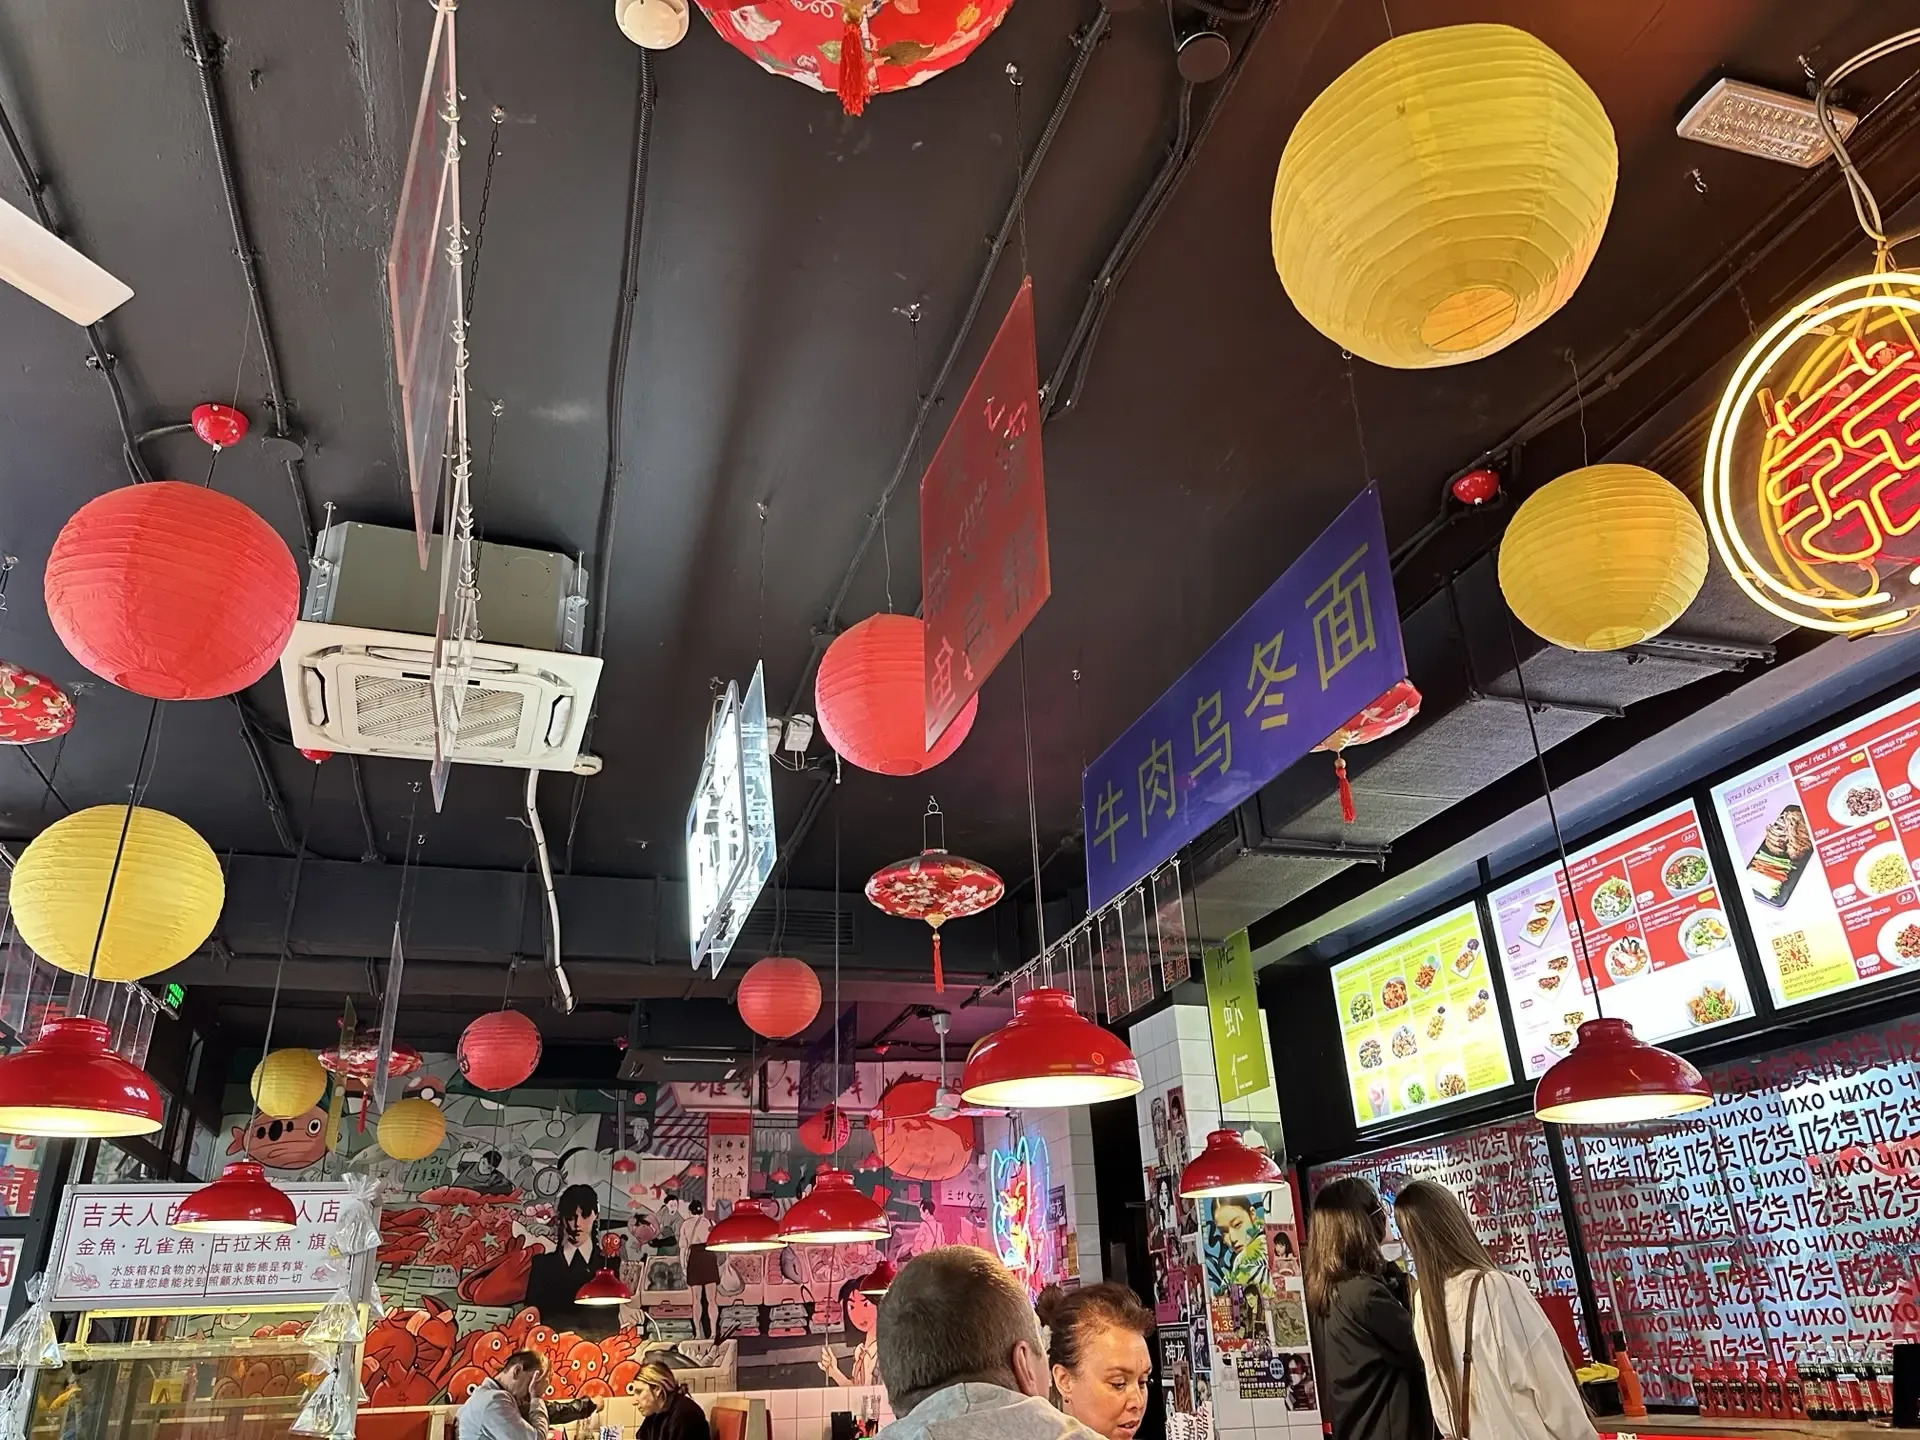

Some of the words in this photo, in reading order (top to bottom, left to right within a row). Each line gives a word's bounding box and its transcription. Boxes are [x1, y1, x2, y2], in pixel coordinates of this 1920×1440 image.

[1093, 542, 1376, 863] 牛肉乌冬面
[1793, 759, 1809, 773] рис
[1811, 750, 1827, 763] rice
[1727, 792, 1743, 804] утка
[1746, 781, 1762, 794] duck
[1815, 1031, 1889, 1083] 吃货
[1710, 1105, 1763, 1130] ЧИХО
[1767, 1092, 1826, 1118] ЧИХО
[1829, 1077, 1894, 1104] ЧИХО
[1897, 1071, 1920, 1092] Ч
[1469, 1127, 1508, 1162] 吃货
[1587, 1153, 1636, 1193] 吃货
[1632, 1143, 1687, 1185] 吃货
[1683, 1133, 1741, 1177] 吃货
[1738, 1121, 1802, 1167] 吃货
[1798, 1109, 1869, 1157] 吃货
[1440, 1168, 1473, 1186] ЧИХО
[1475, 1161, 1509, 1179] ЧИХО
[1594, 1193, 1639, 1213] ЧИХО
[1641, 1184, 1690, 1206] ЧИХО
[1692, 1175, 1745, 1199] ЧИХО
[1750, 1166, 1806, 1189] ЧИХО
[1810, 1154, 1873, 1179] ЧИХО
[83, 1199, 340, 1228] 吉夫人的人店
[1472, 1218, 1498, 1233] ИХО
[1500, 1211, 1537, 1229] ЧИХО
[1627, 1208, 1682, 1247] 吃货
[1677, 1199, 1737, 1241] 吃货
[1733, 1191, 1796, 1237] 吃货
[1792, 1184, 1862, 1229] 吃货
[1528, 1227, 1570, 1262] 吃货
[1589, 1256, 1632, 1275] ЧИХО
[1637, 1250, 1684, 1271] ЧИХО
[1687, 1244, 1740, 1264] ЧИХО
[1744, 1238, 1800, 1260] ЧИХО
[1804, 1230, 1867, 1253] ЧИХО
[1534, 1265, 1574, 1282] ЧИХО
[1661, 1268, 1719, 1309] 吃货
[1715, 1265, 1777, 1306] 吃货
[1774, 1257, 1842, 1302] 吃货
[1837, 1251, 1914, 1298] 吃货
[460, 1309, 499, 1323] カニ
[1671, 1312, 1723, 1331] ЧИХО
[1726, 1310, 1782, 1329] ЧИХО
[1785, 1307, 1847, 1327] ЧИХО
[1851, 1302, 1920, 1325] ЧИХО
